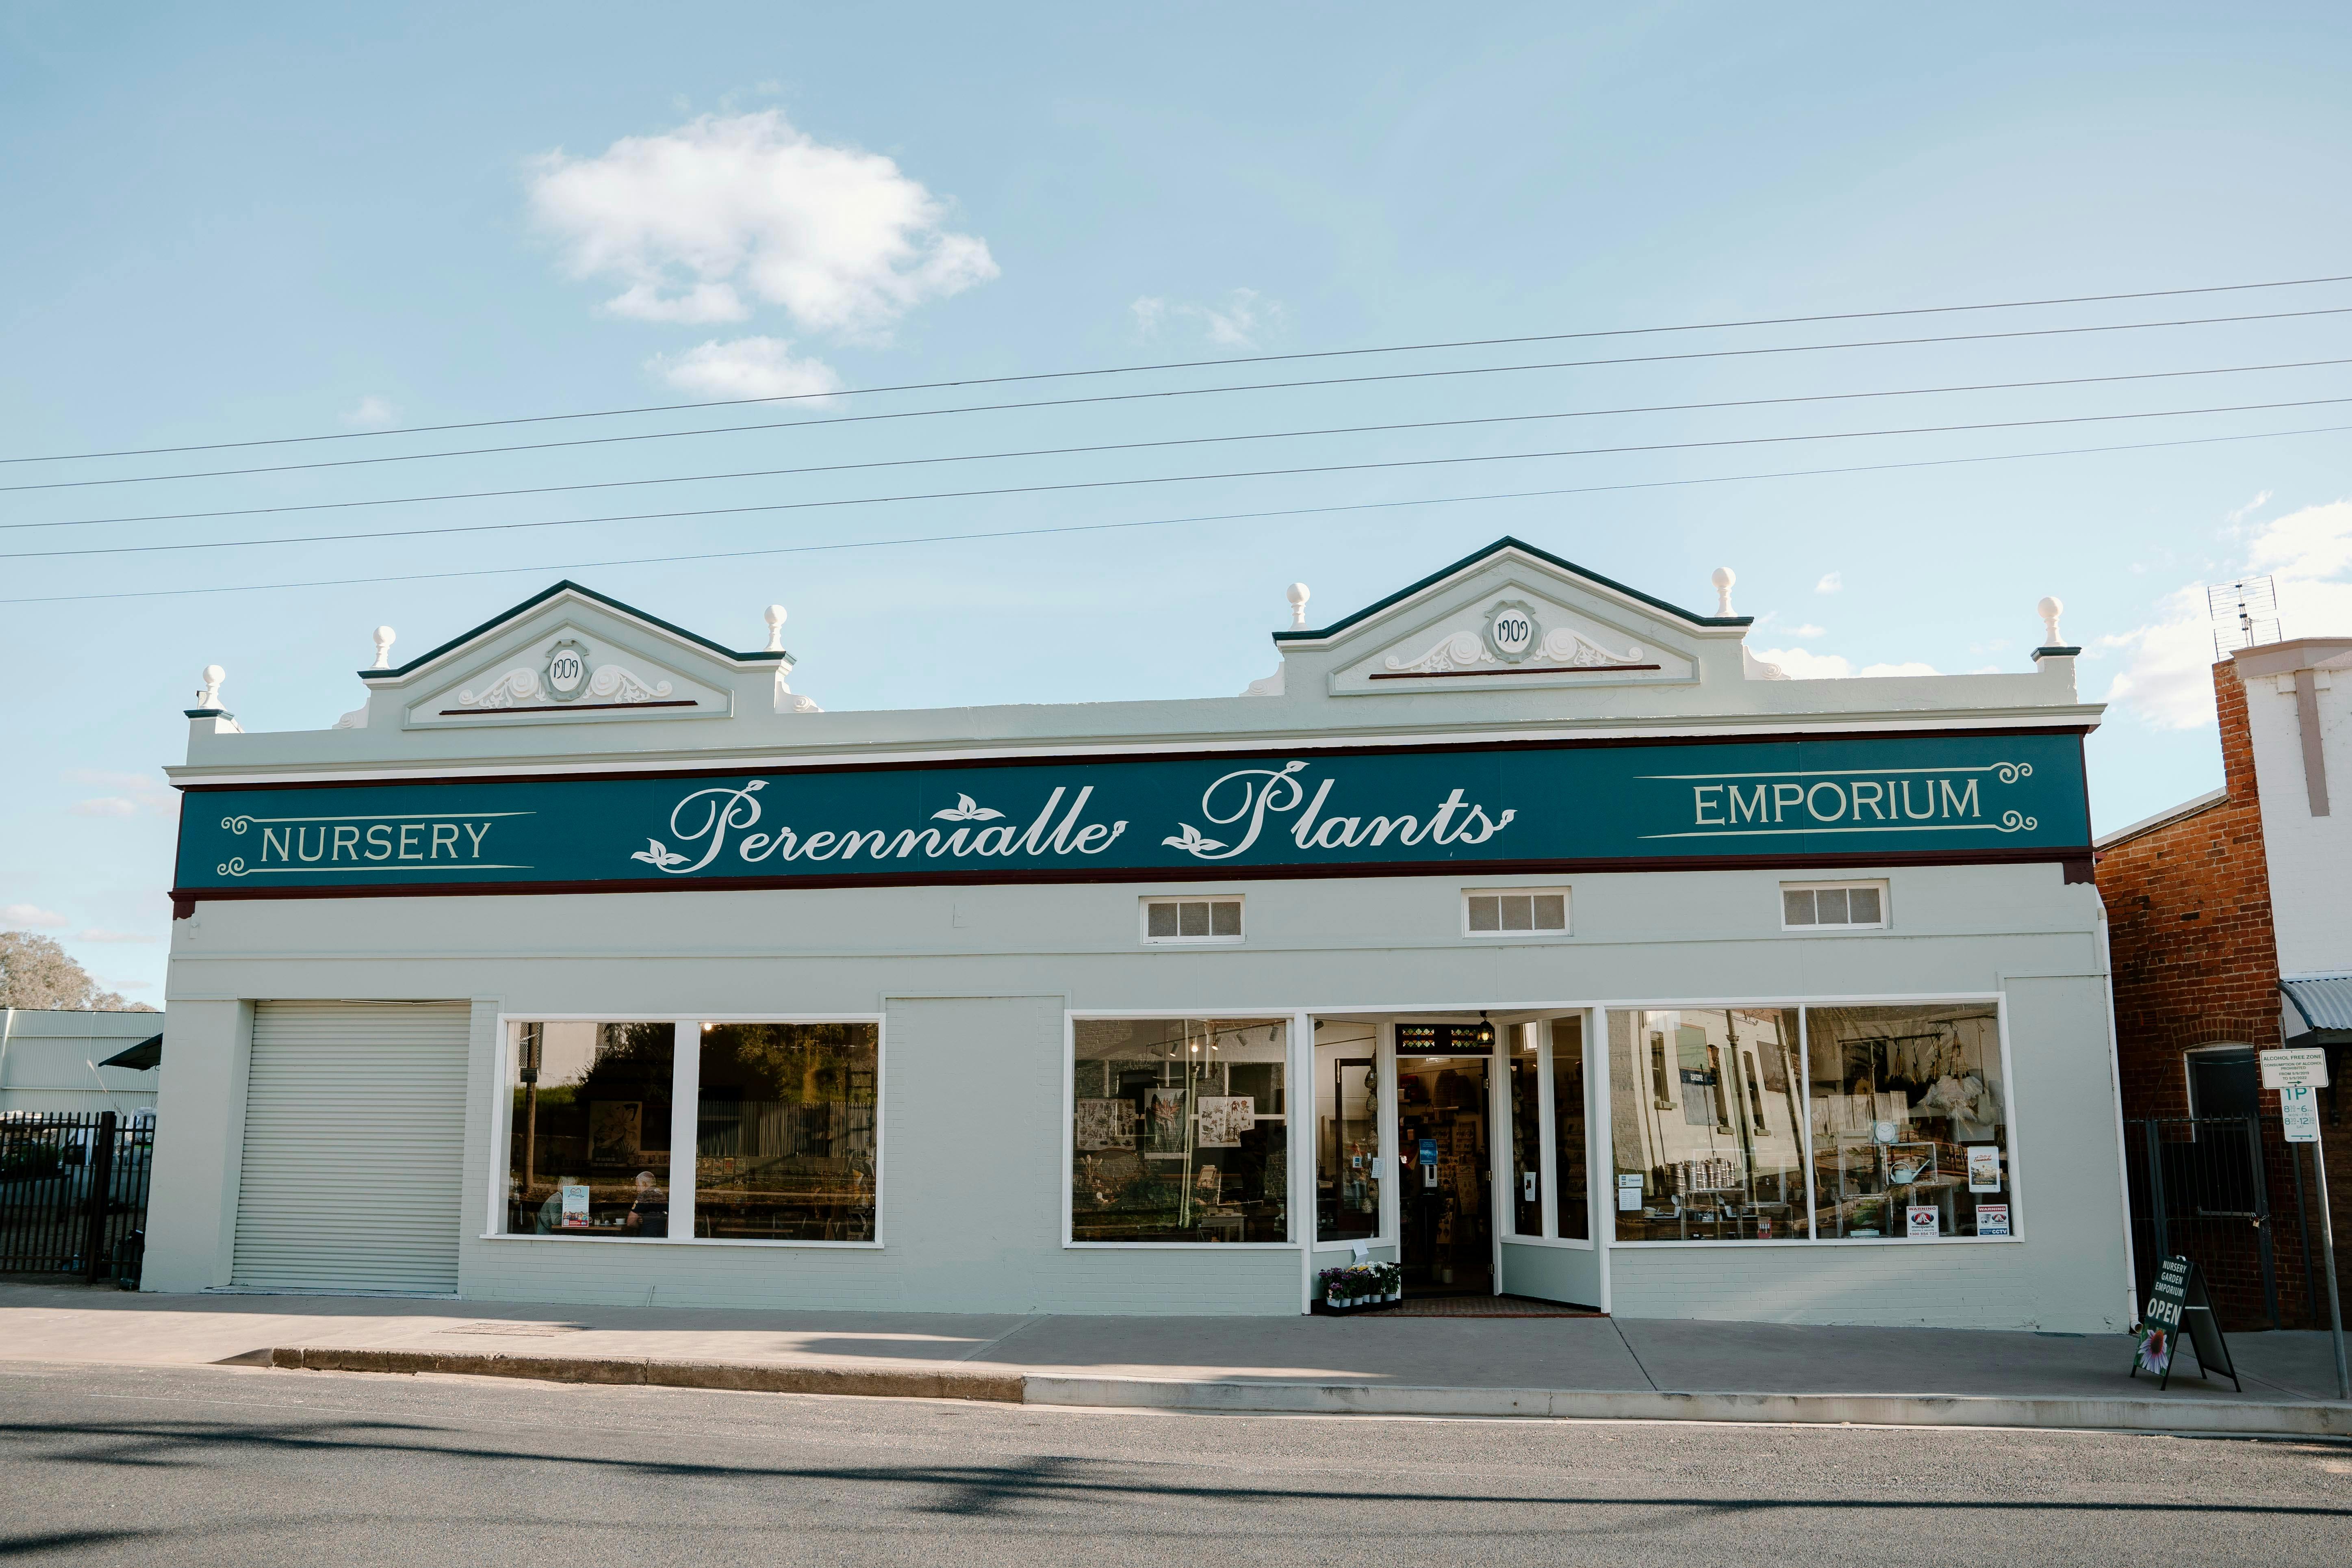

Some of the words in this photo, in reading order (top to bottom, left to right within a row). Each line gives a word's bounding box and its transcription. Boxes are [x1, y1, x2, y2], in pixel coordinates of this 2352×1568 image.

[1498, 620, 1528, 642] 1909
[554, 658, 578, 679] 1909
[1693, 779, 1981, 826] EMPORIUM
[650, 785, 1125, 874] Perennialle
[1180, 765, 1511, 859] Plants
[261, 822, 492, 862] NURSERY
[2286, 1088, 2307, 1100] 1P
[2163, 1260, 2187, 1274] NURSERY
[2161, 1272, 2183, 1285] GARDEN
[2155, 1282, 2183, 1297] EMPORIUM
[2147, 1298, 2181, 1325] OPEN
